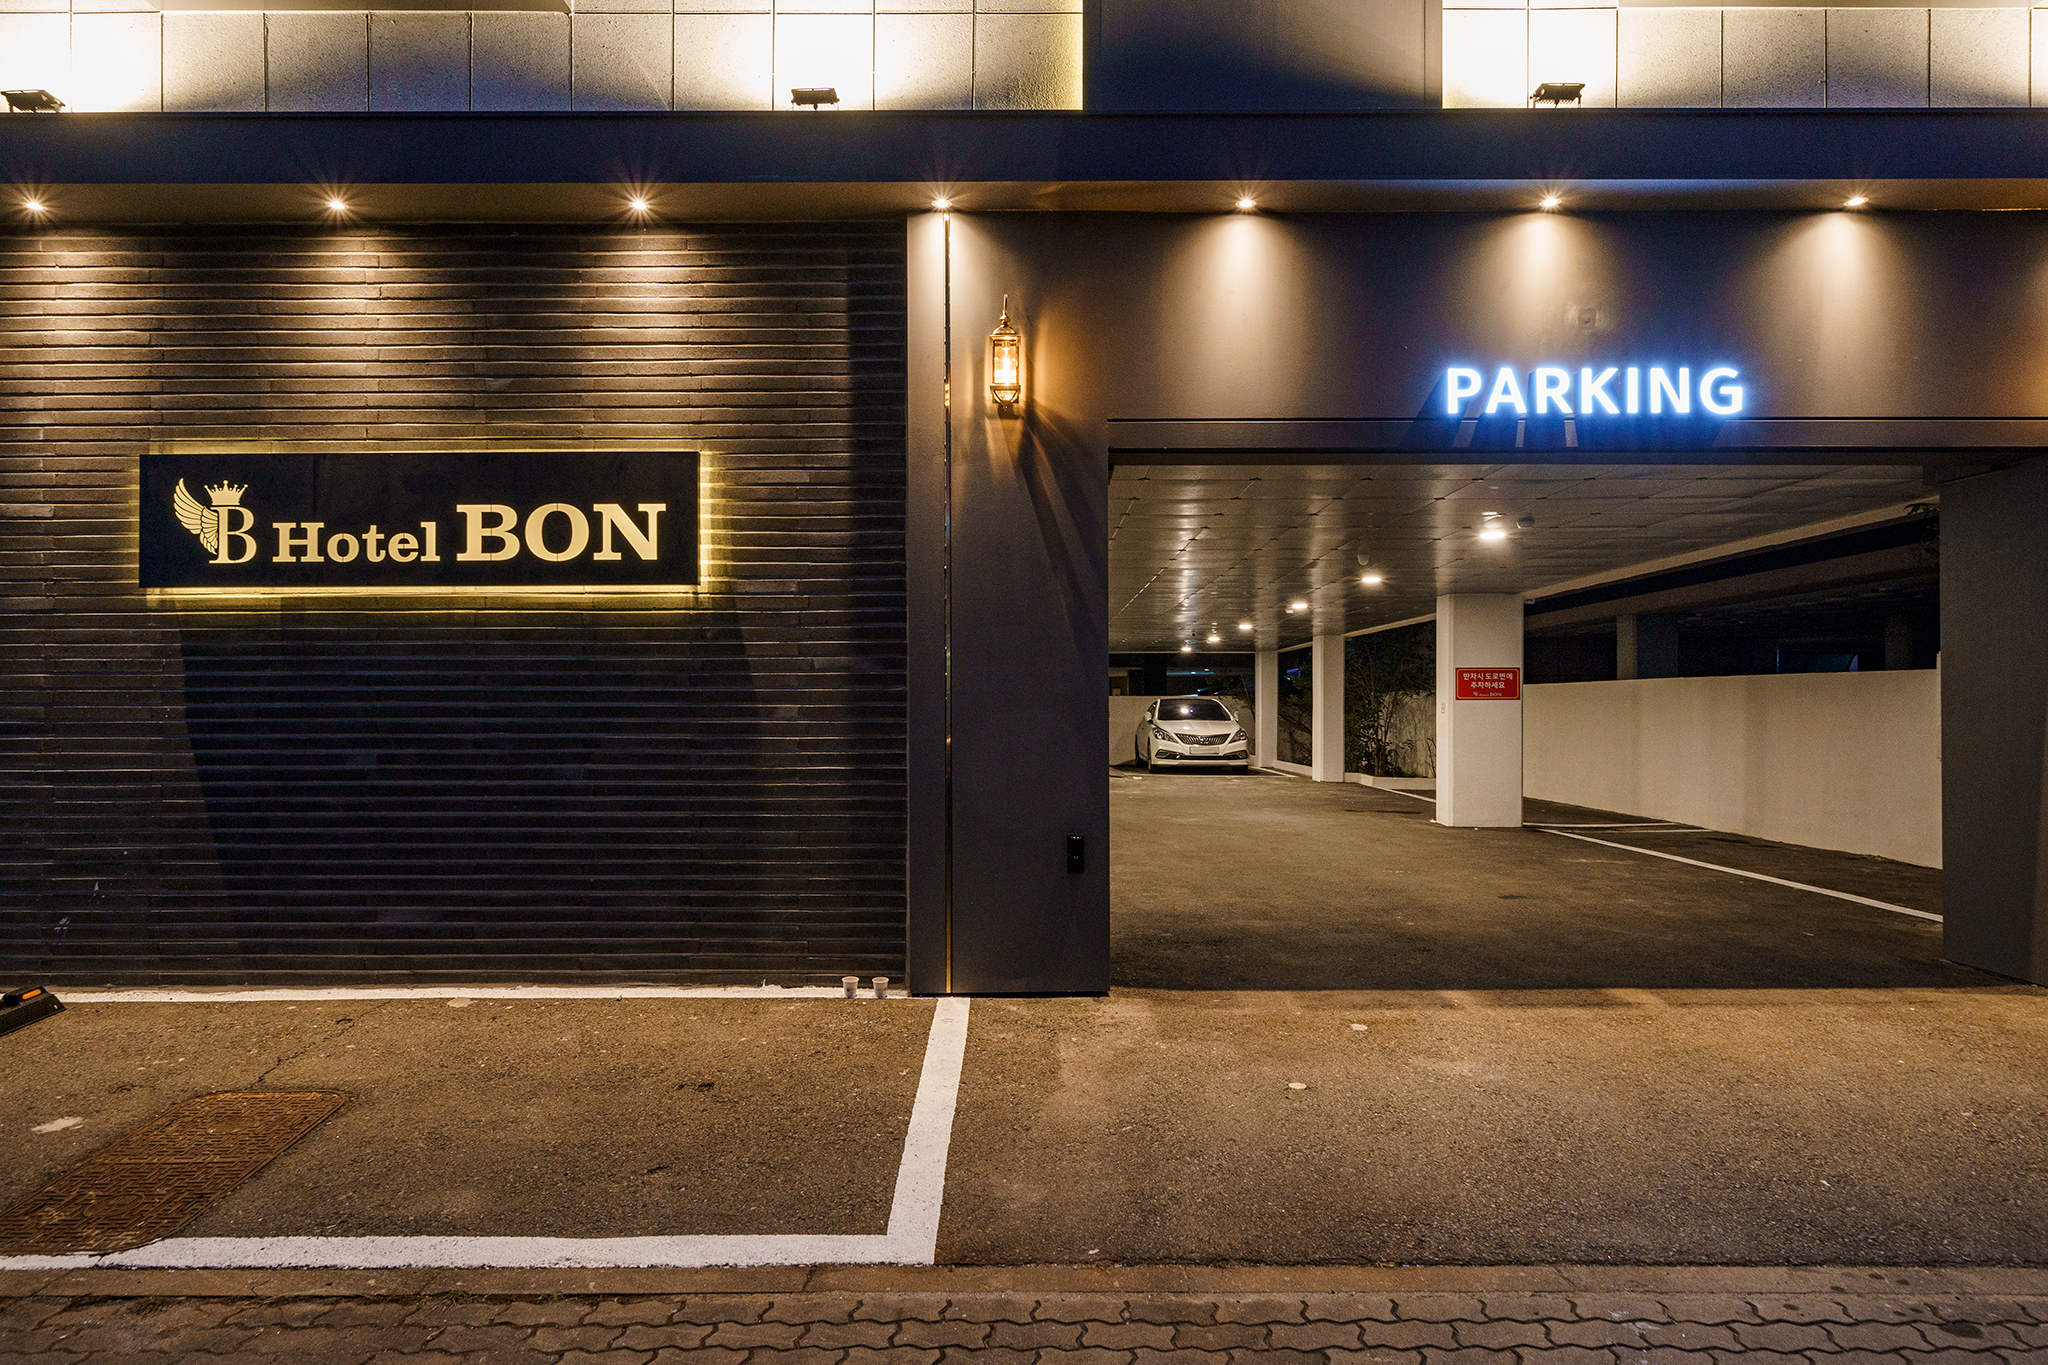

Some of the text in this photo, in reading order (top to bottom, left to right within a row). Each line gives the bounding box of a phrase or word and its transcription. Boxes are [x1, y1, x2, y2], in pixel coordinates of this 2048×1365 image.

[1446, 367, 1744, 416] PARKING
[272, 521, 440, 563] Hotel
[456, 502, 667, 562] BON
[1470, 681, 1505, 689] 주차하세요
